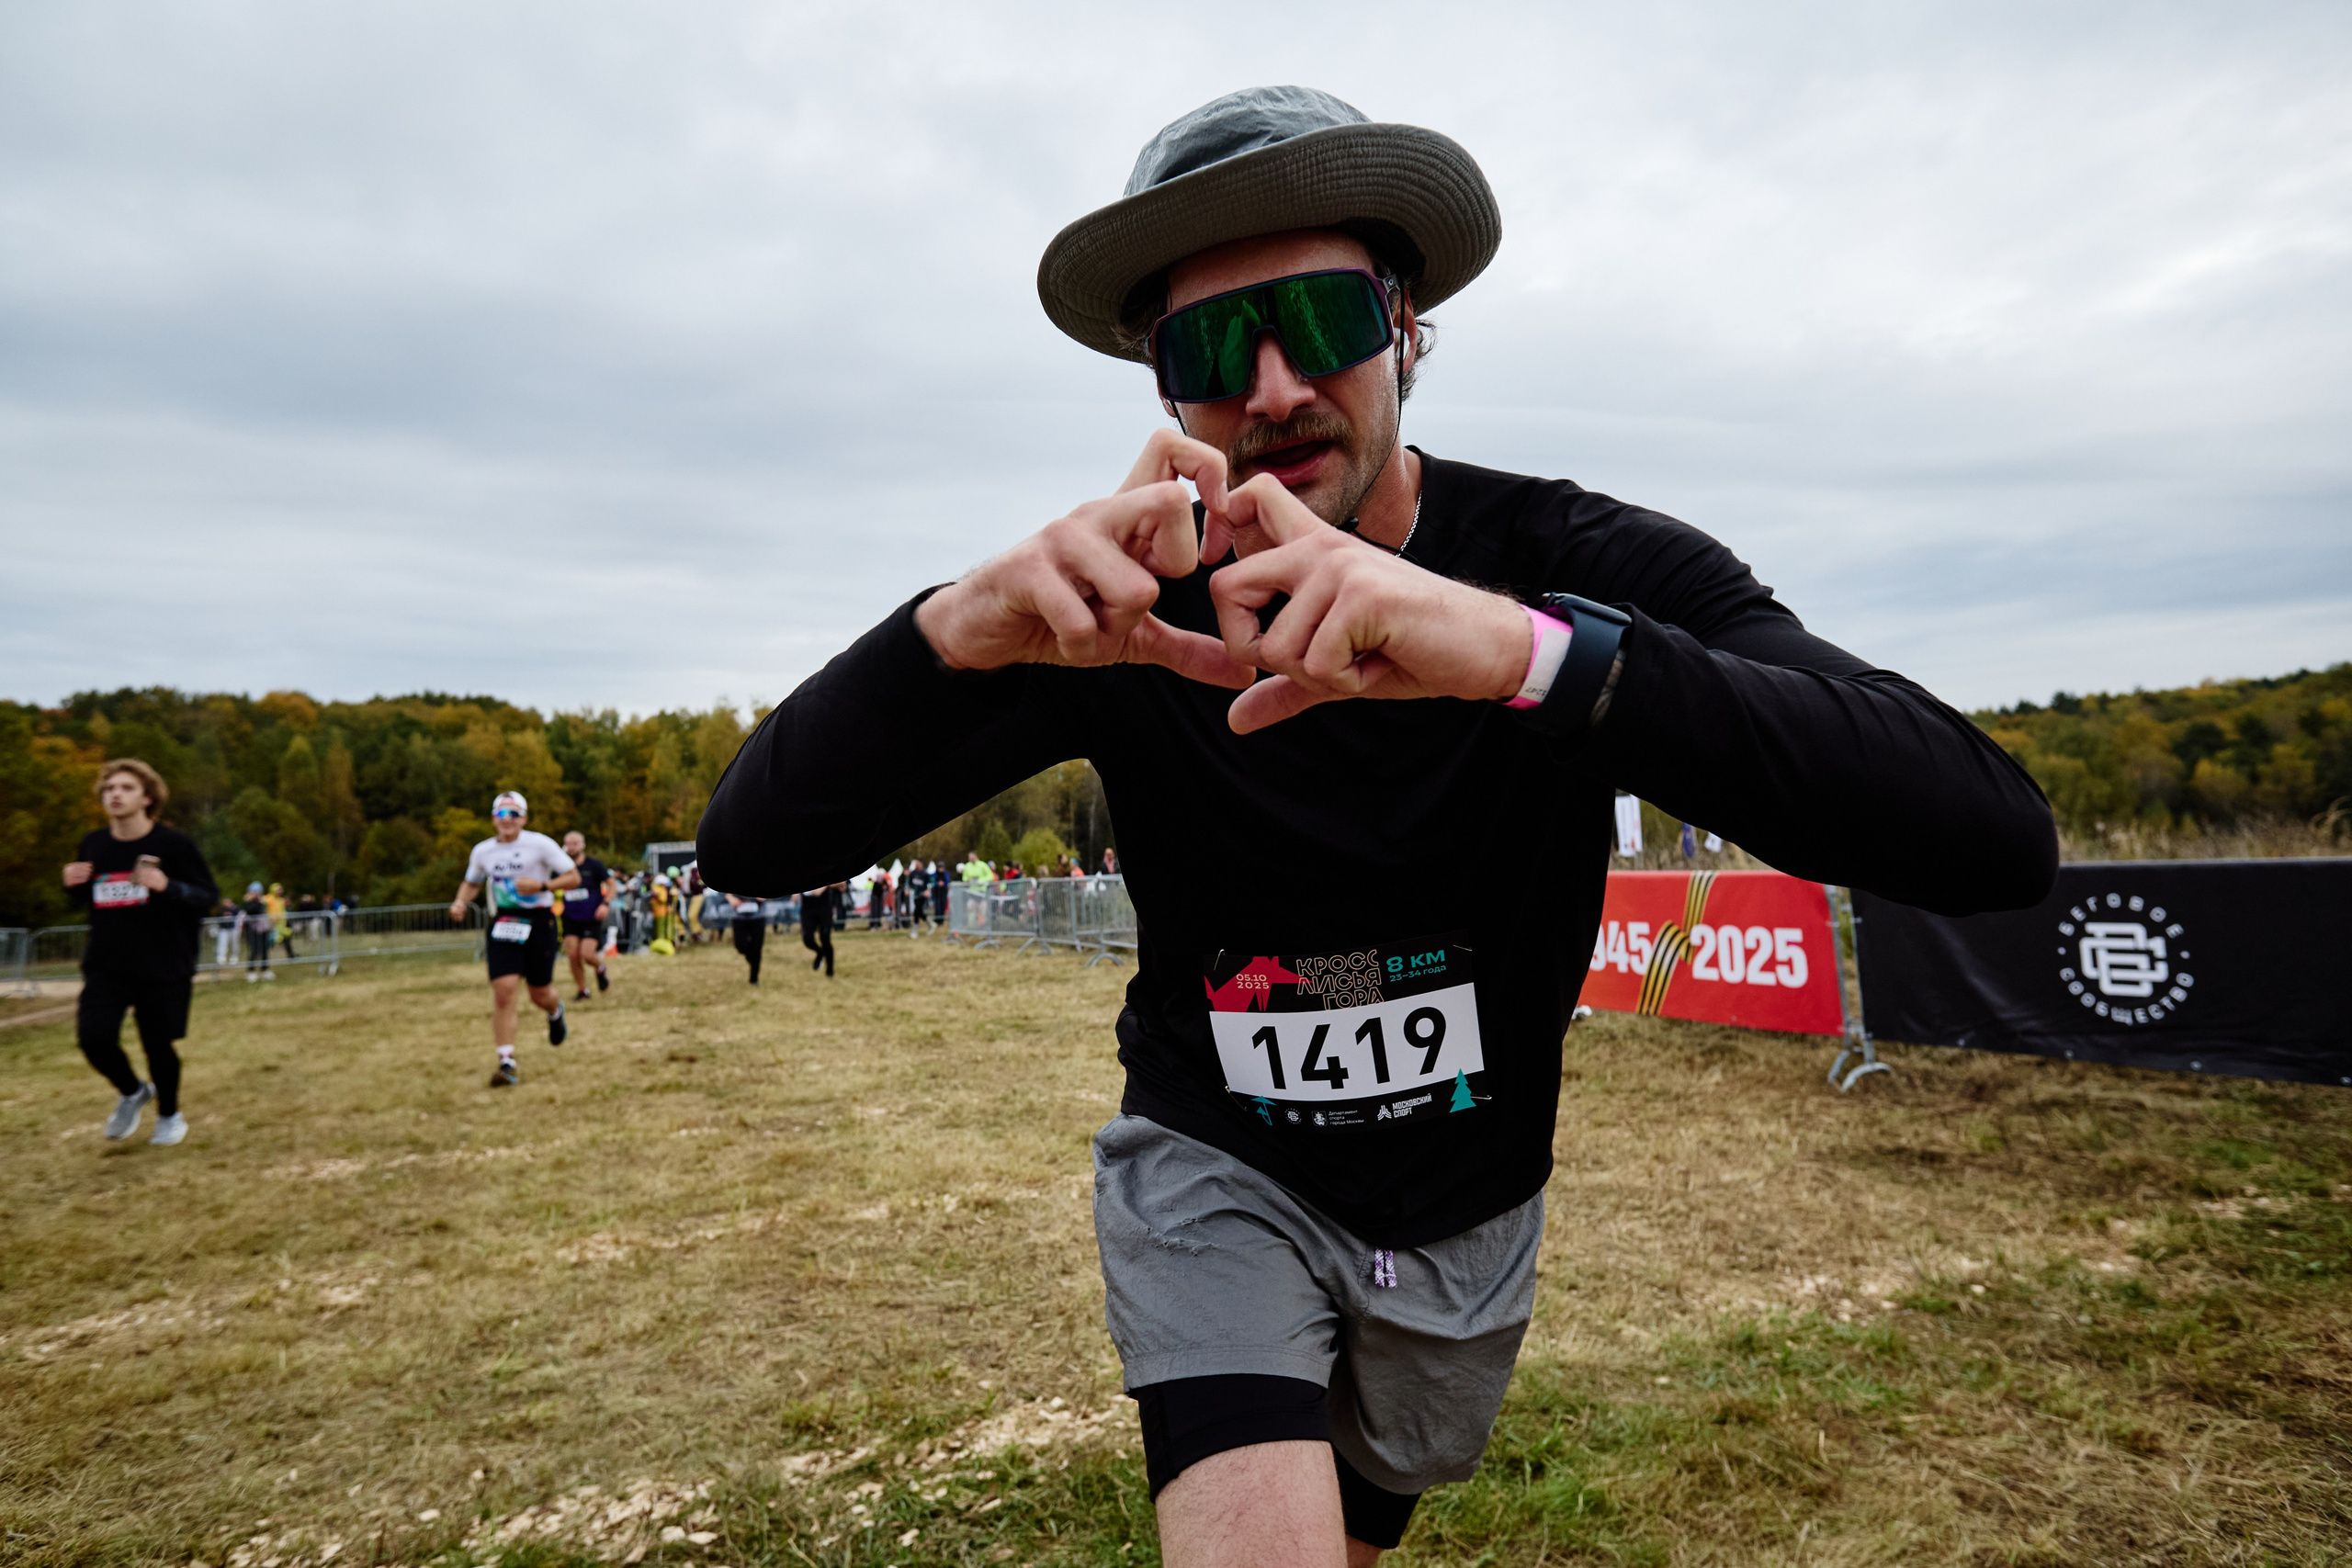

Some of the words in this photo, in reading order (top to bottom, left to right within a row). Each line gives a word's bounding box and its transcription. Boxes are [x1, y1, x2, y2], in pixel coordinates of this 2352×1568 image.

[2058, 892, 2185, 939] БЕГОВОЕ
[1296, 949, 1379, 976] КРОСС
[1385, 956, 1404, 973] 8
[1690, 924, 1809, 988] 2025
[1236, 974, 1267, 982] 05.10
[1296, 967, 1382, 995] ЛИСЬЯ
[1423, 964, 1447, 976] года
[1237, 981, 1270, 989] 2025
[2060, 967, 2195, 1026] СООБЩЕСТВО
[1323, 987, 1385, 1010] ГОРА
[1251, 1006, 1447, 1090] 1419
[1392, 1093, 1432, 1111] МОСКОВСКИЙ
[1394, 1107, 1412, 1118] СПОРТ
